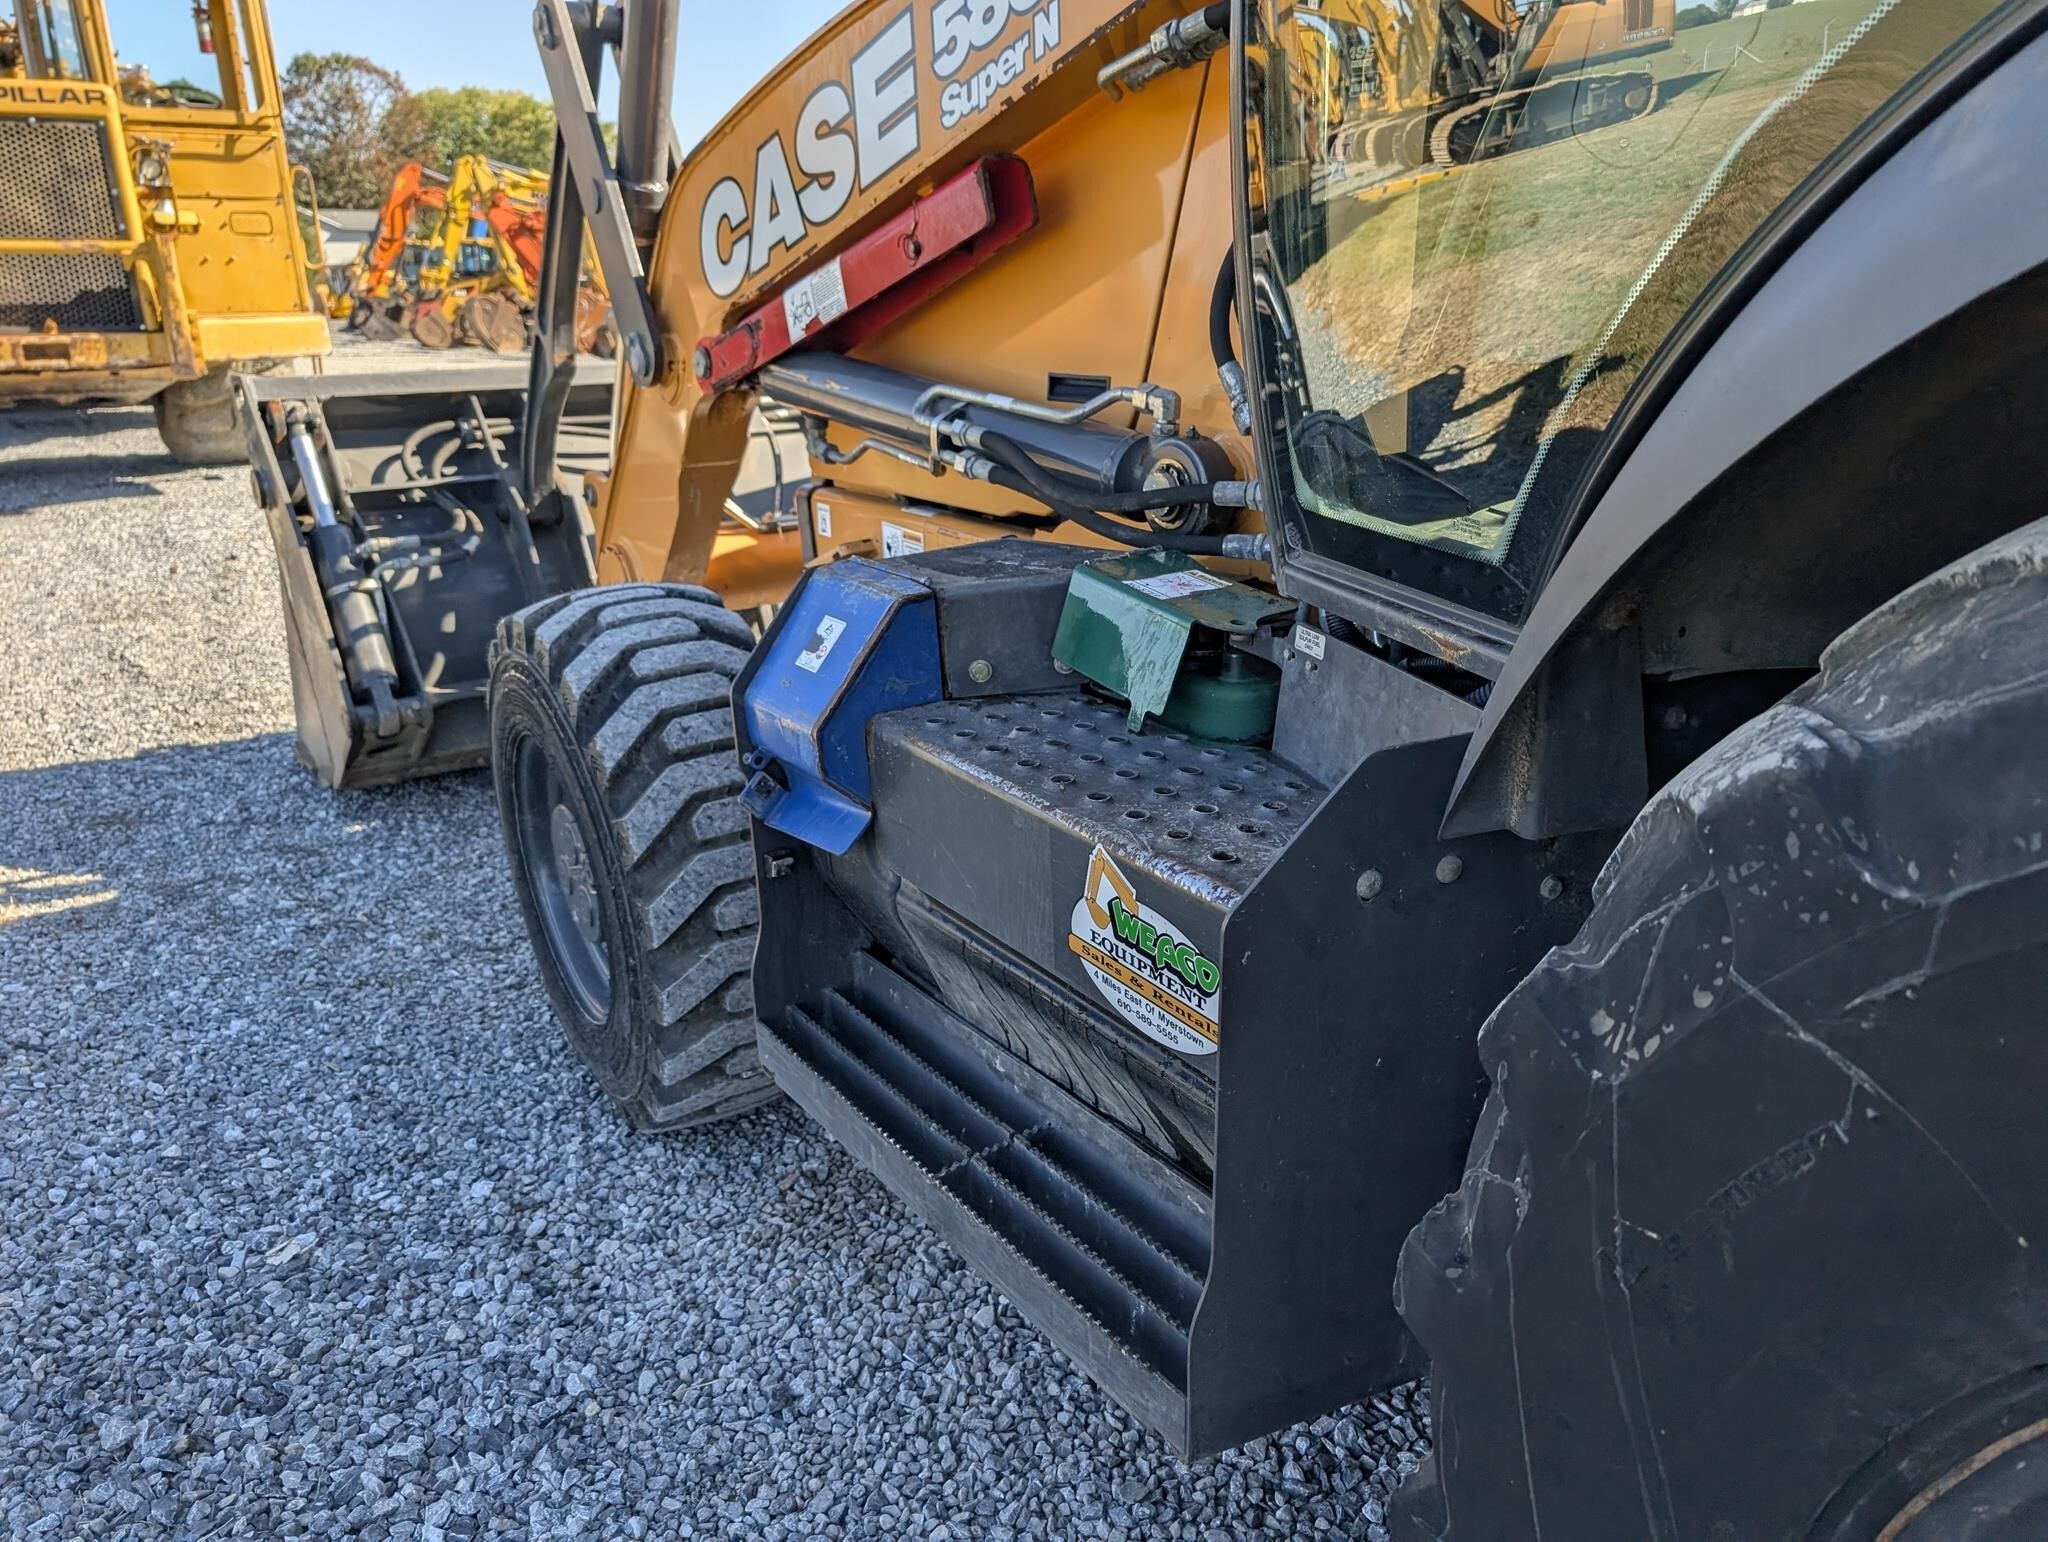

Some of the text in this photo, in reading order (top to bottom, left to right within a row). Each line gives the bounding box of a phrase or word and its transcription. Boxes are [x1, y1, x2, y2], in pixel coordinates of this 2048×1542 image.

[932, 0, 1042, 80] 58
[940, 0, 1060, 129] Super N
[700, 6, 920, 298] CASE
[1081, 944, 1218, 1038] Sales & Rentals
[1090, 929, 1207, 1011] EQUIPMENT
[1109, 898, 1220, 996] WEACO
[1093, 971, 1204, 1049] 4 Miles East Of Myerstown
[1117, 998, 1179, 1045] 610-589-5555
